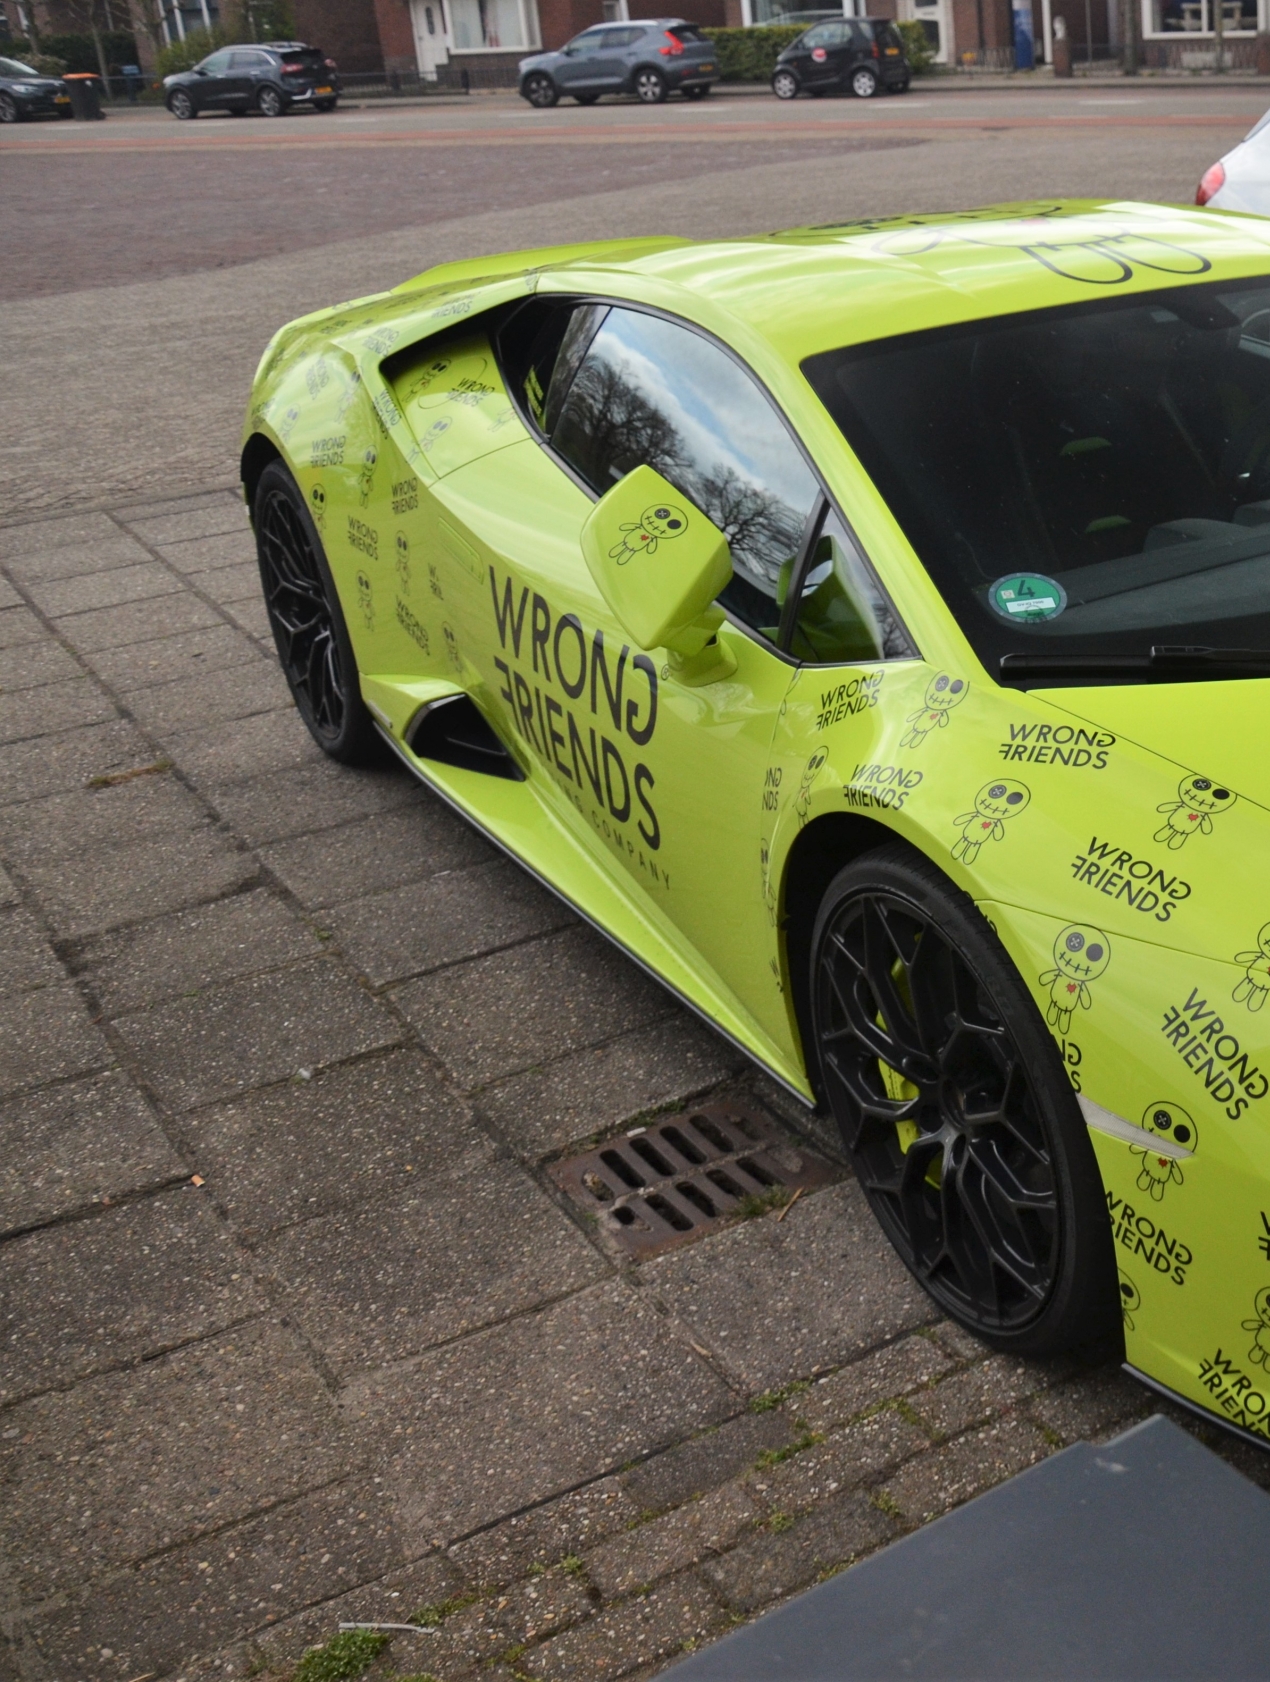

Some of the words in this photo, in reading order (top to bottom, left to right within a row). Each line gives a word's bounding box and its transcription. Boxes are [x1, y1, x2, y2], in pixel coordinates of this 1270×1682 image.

[391, 477, 418, 499] WRONG
[347, 514, 379, 545] WRONG
[1017, 579, 1036, 597] 4
[489, 564, 658, 747] WRONG
[816, 689, 880, 732] FRIENDS
[820, 669, 885, 711] WRONG
[493, 655, 661, 852] FRIENDS
[1008, 722, 1117, 748] WRONG
[850, 763, 924, 789] WRONG
[998, 743, 1110, 770] FRIENDS
[843, 784, 910, 811] FRIENDS
[1070, 854, 1178, 923] FRIENDS
[1087, 836, 1193, 901] WRONG
[1160, 1005, 1250, 1121] FRIENDS
[1182, 986, 1270, 1100] WRONG
